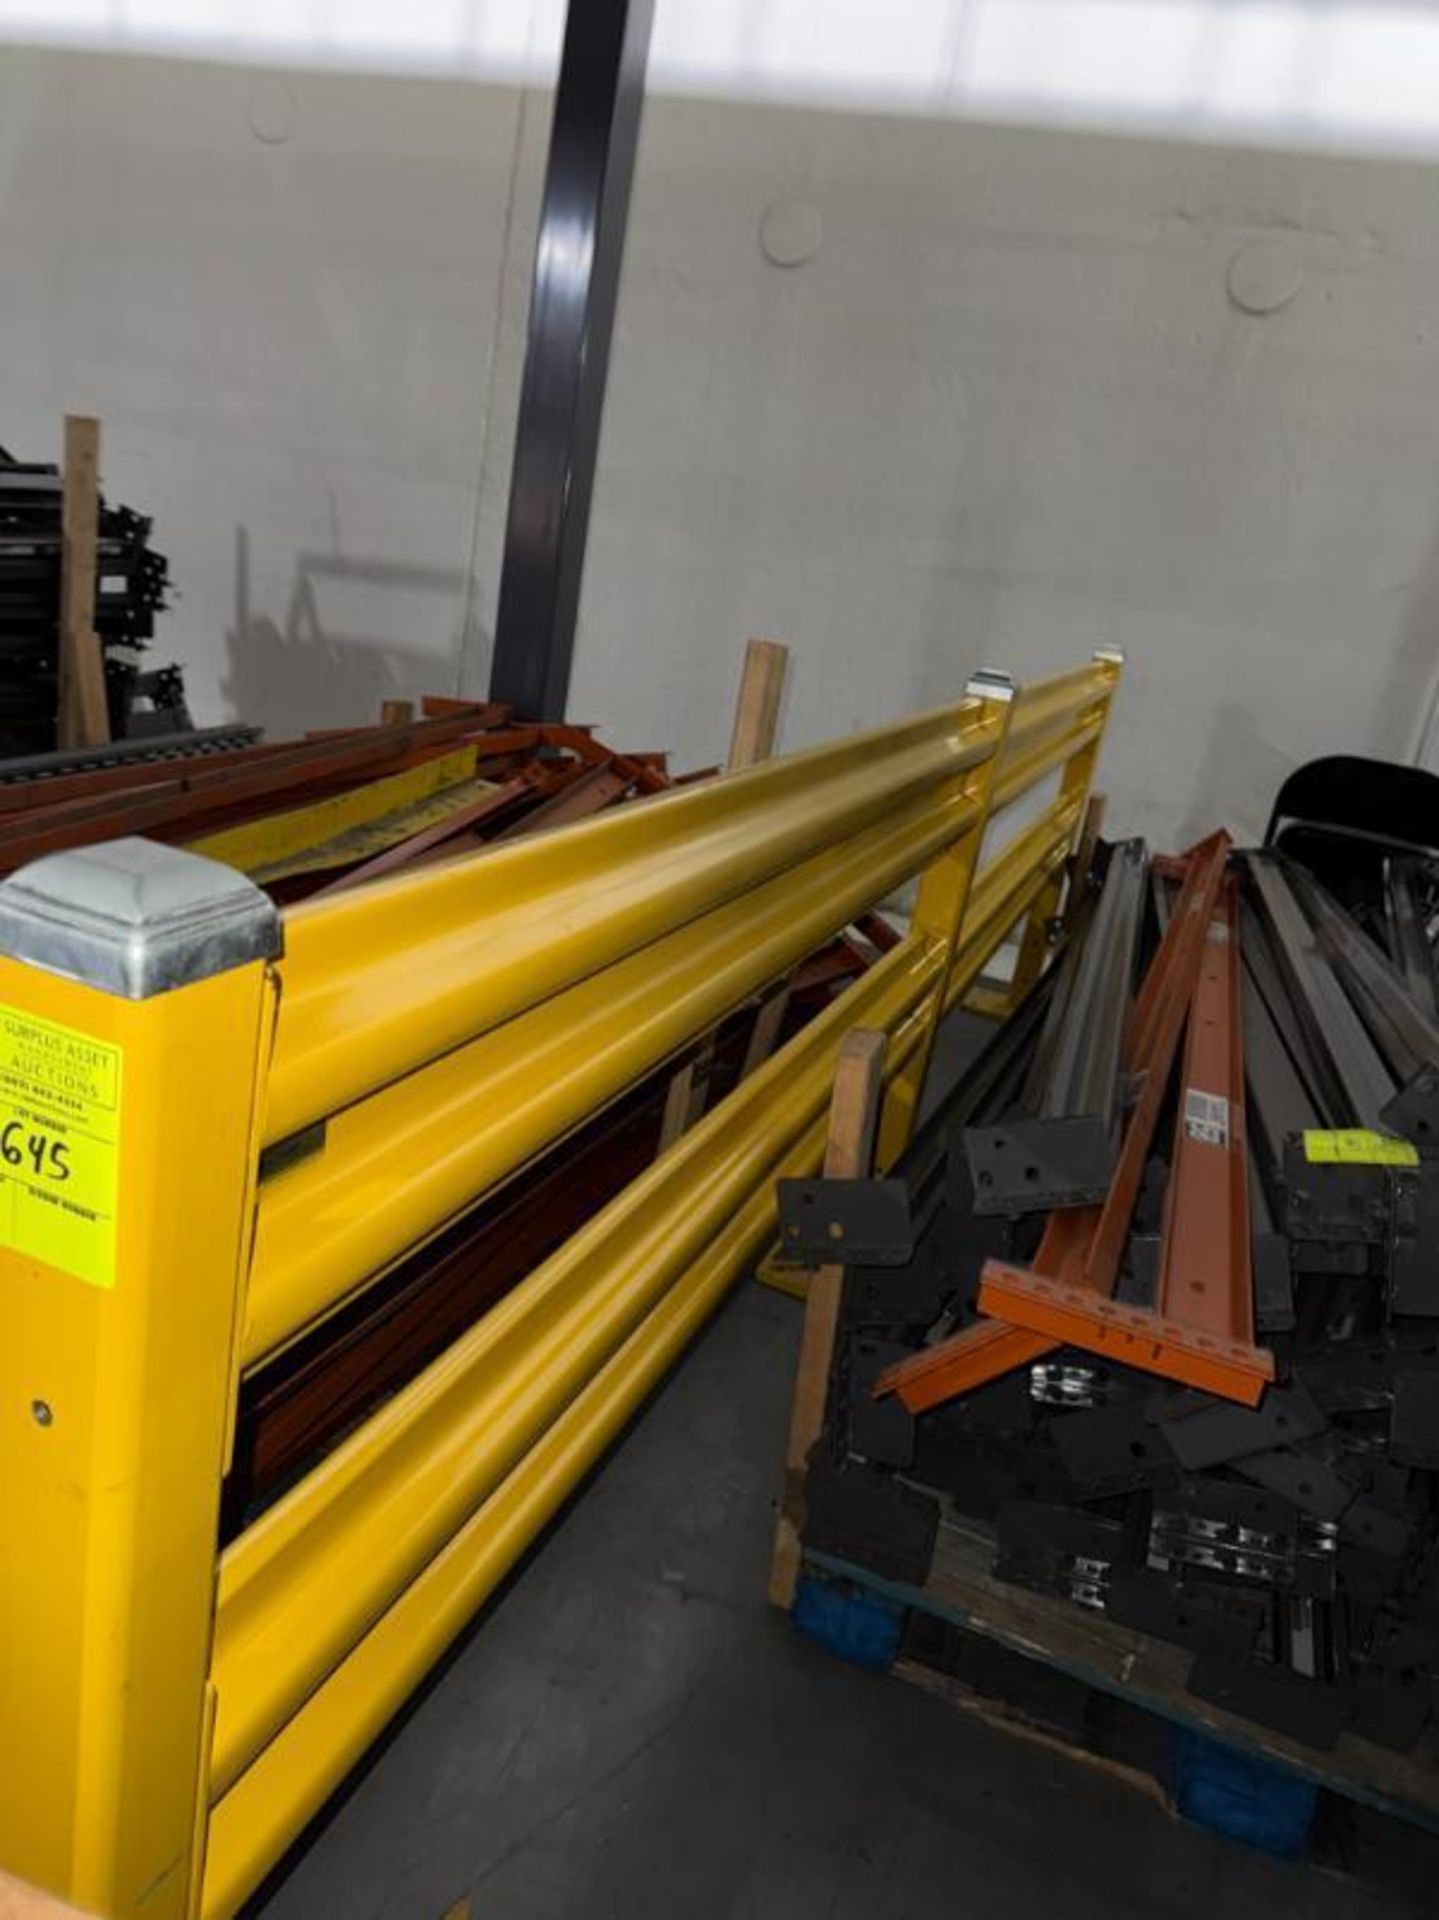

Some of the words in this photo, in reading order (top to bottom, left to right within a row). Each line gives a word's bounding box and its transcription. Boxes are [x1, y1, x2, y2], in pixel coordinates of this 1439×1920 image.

[4, 1019, 62, 1053] SURPLUS
[66, 1043, 108, 1068] ASSET
[11, 1055, 98, 1098] AUCTIONS
[2, 1121, 70, 1180] 645
